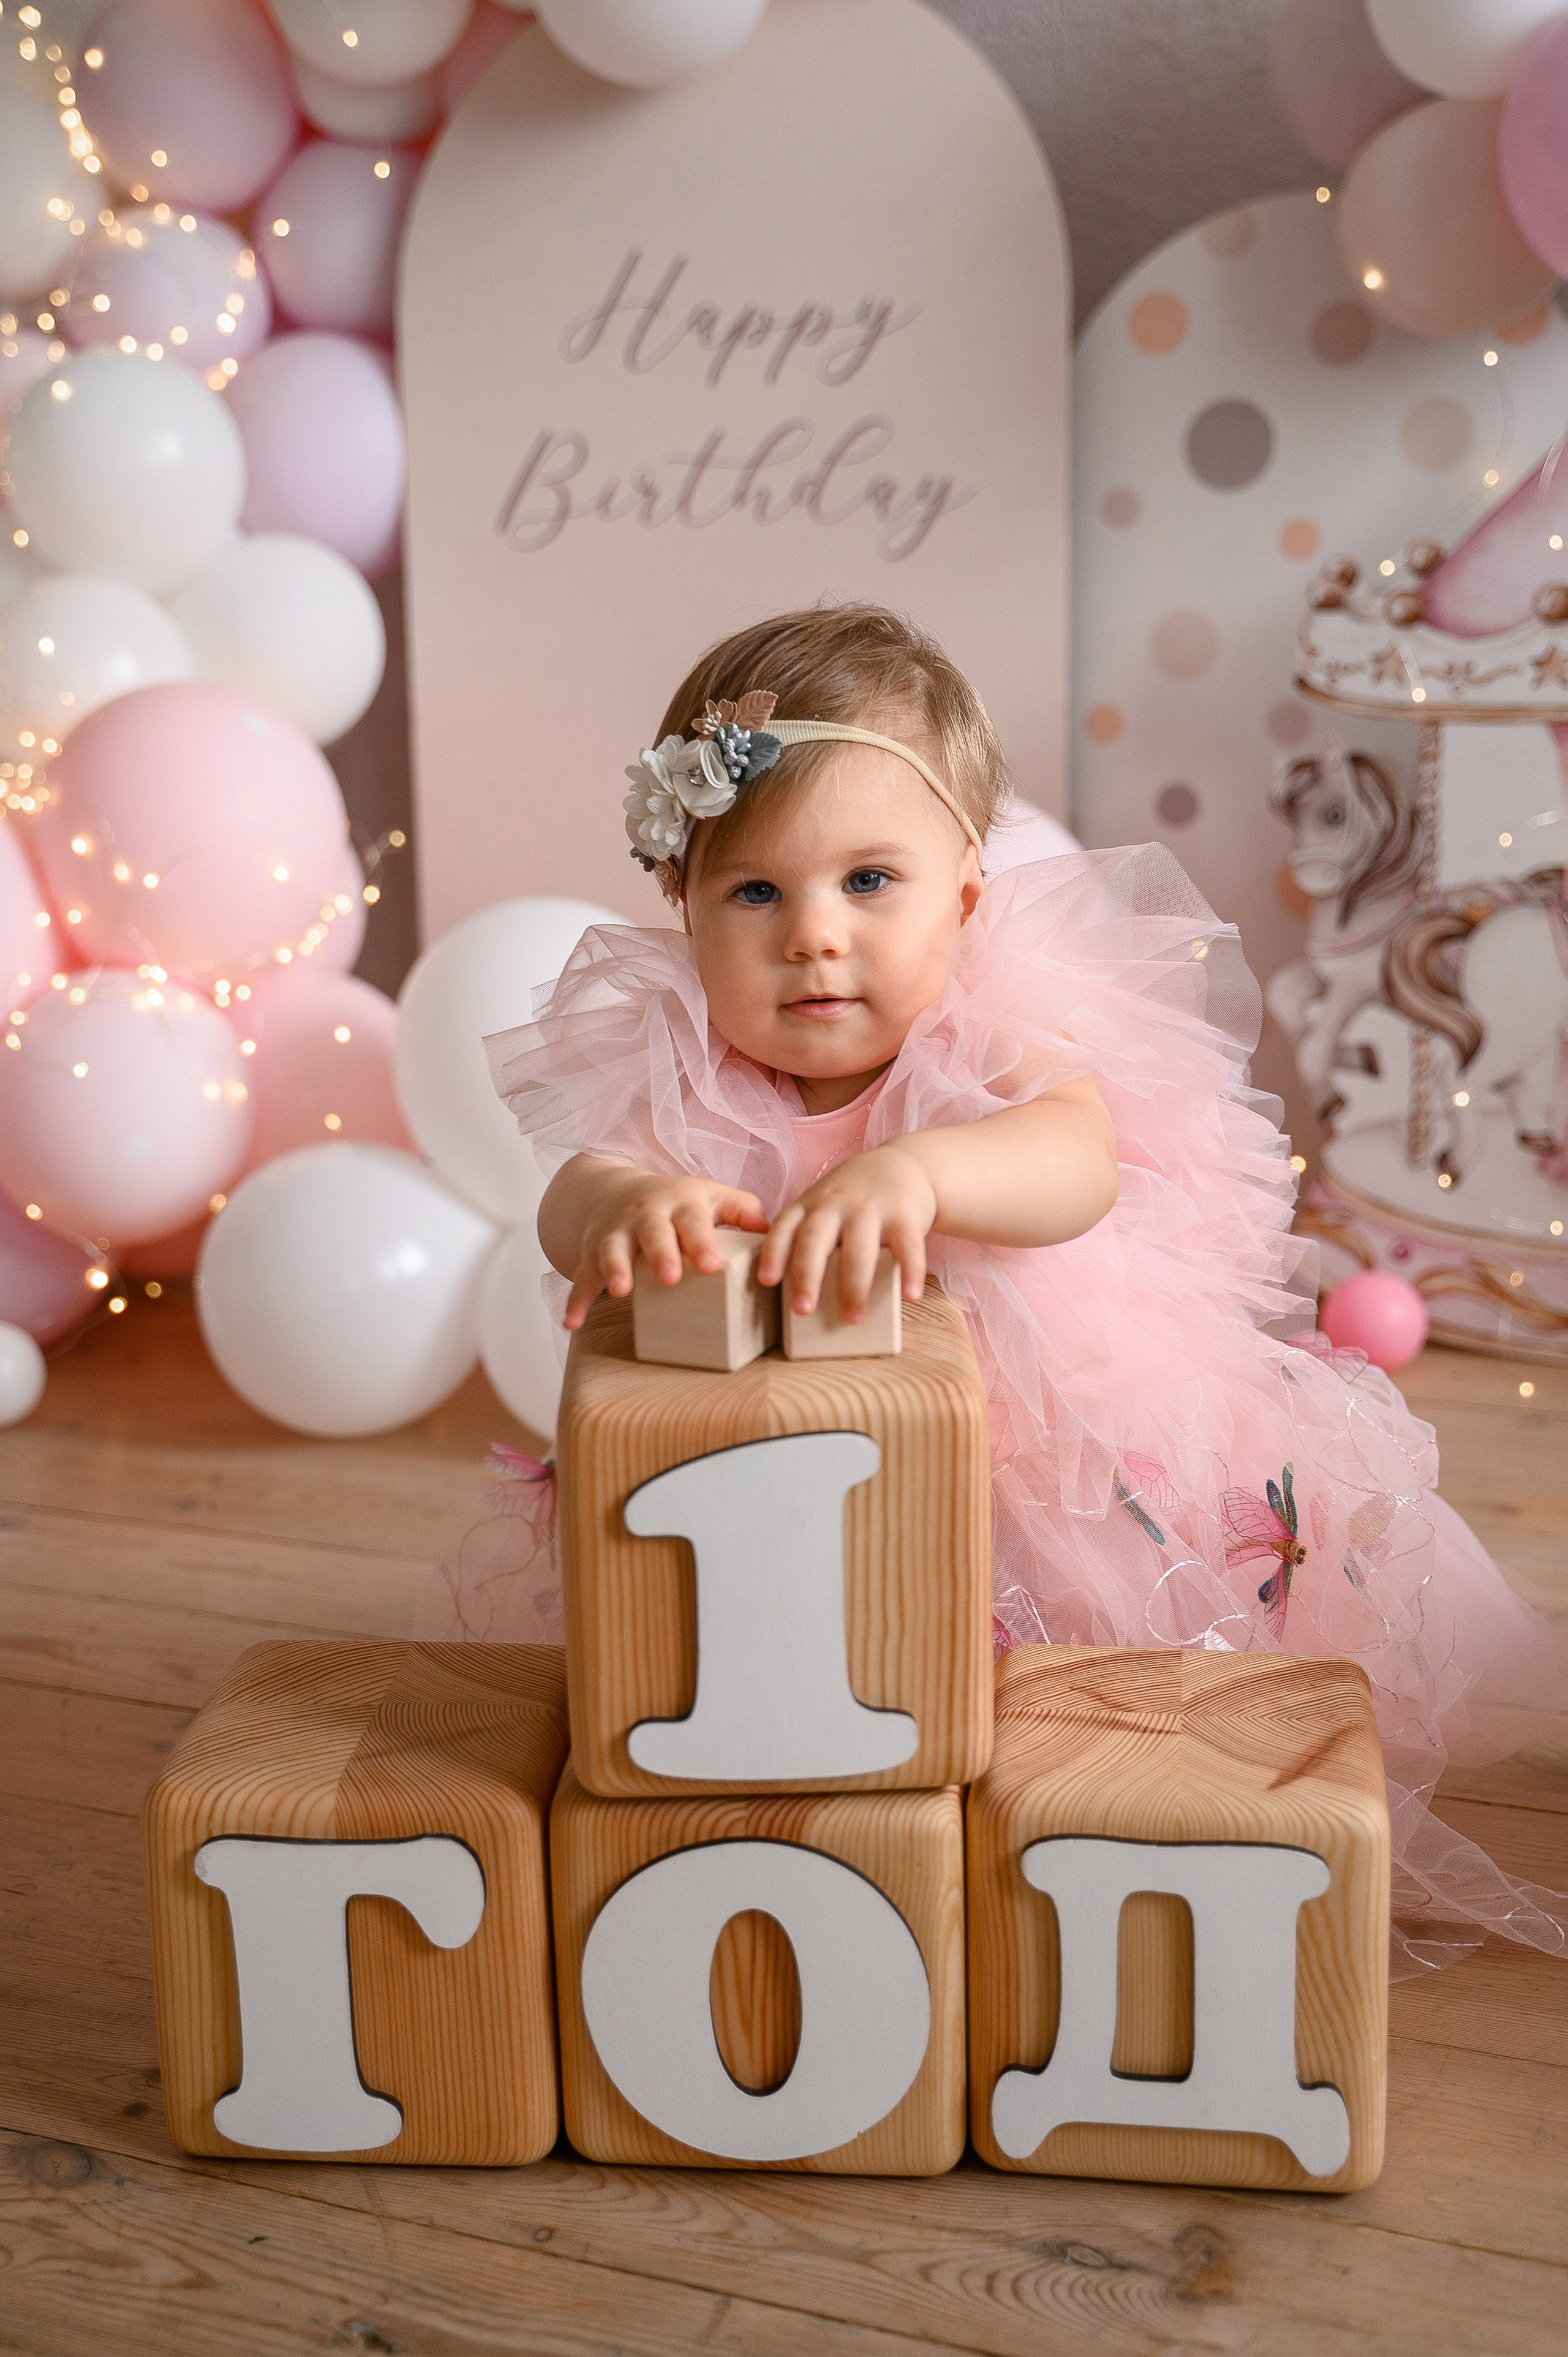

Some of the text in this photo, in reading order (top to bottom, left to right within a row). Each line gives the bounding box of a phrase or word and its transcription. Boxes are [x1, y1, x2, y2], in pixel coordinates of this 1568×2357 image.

[557, 246, 925, 391] Happy
[491, 412, 981, 564] Birthday
[622, 1428, 920, 1782] 1
